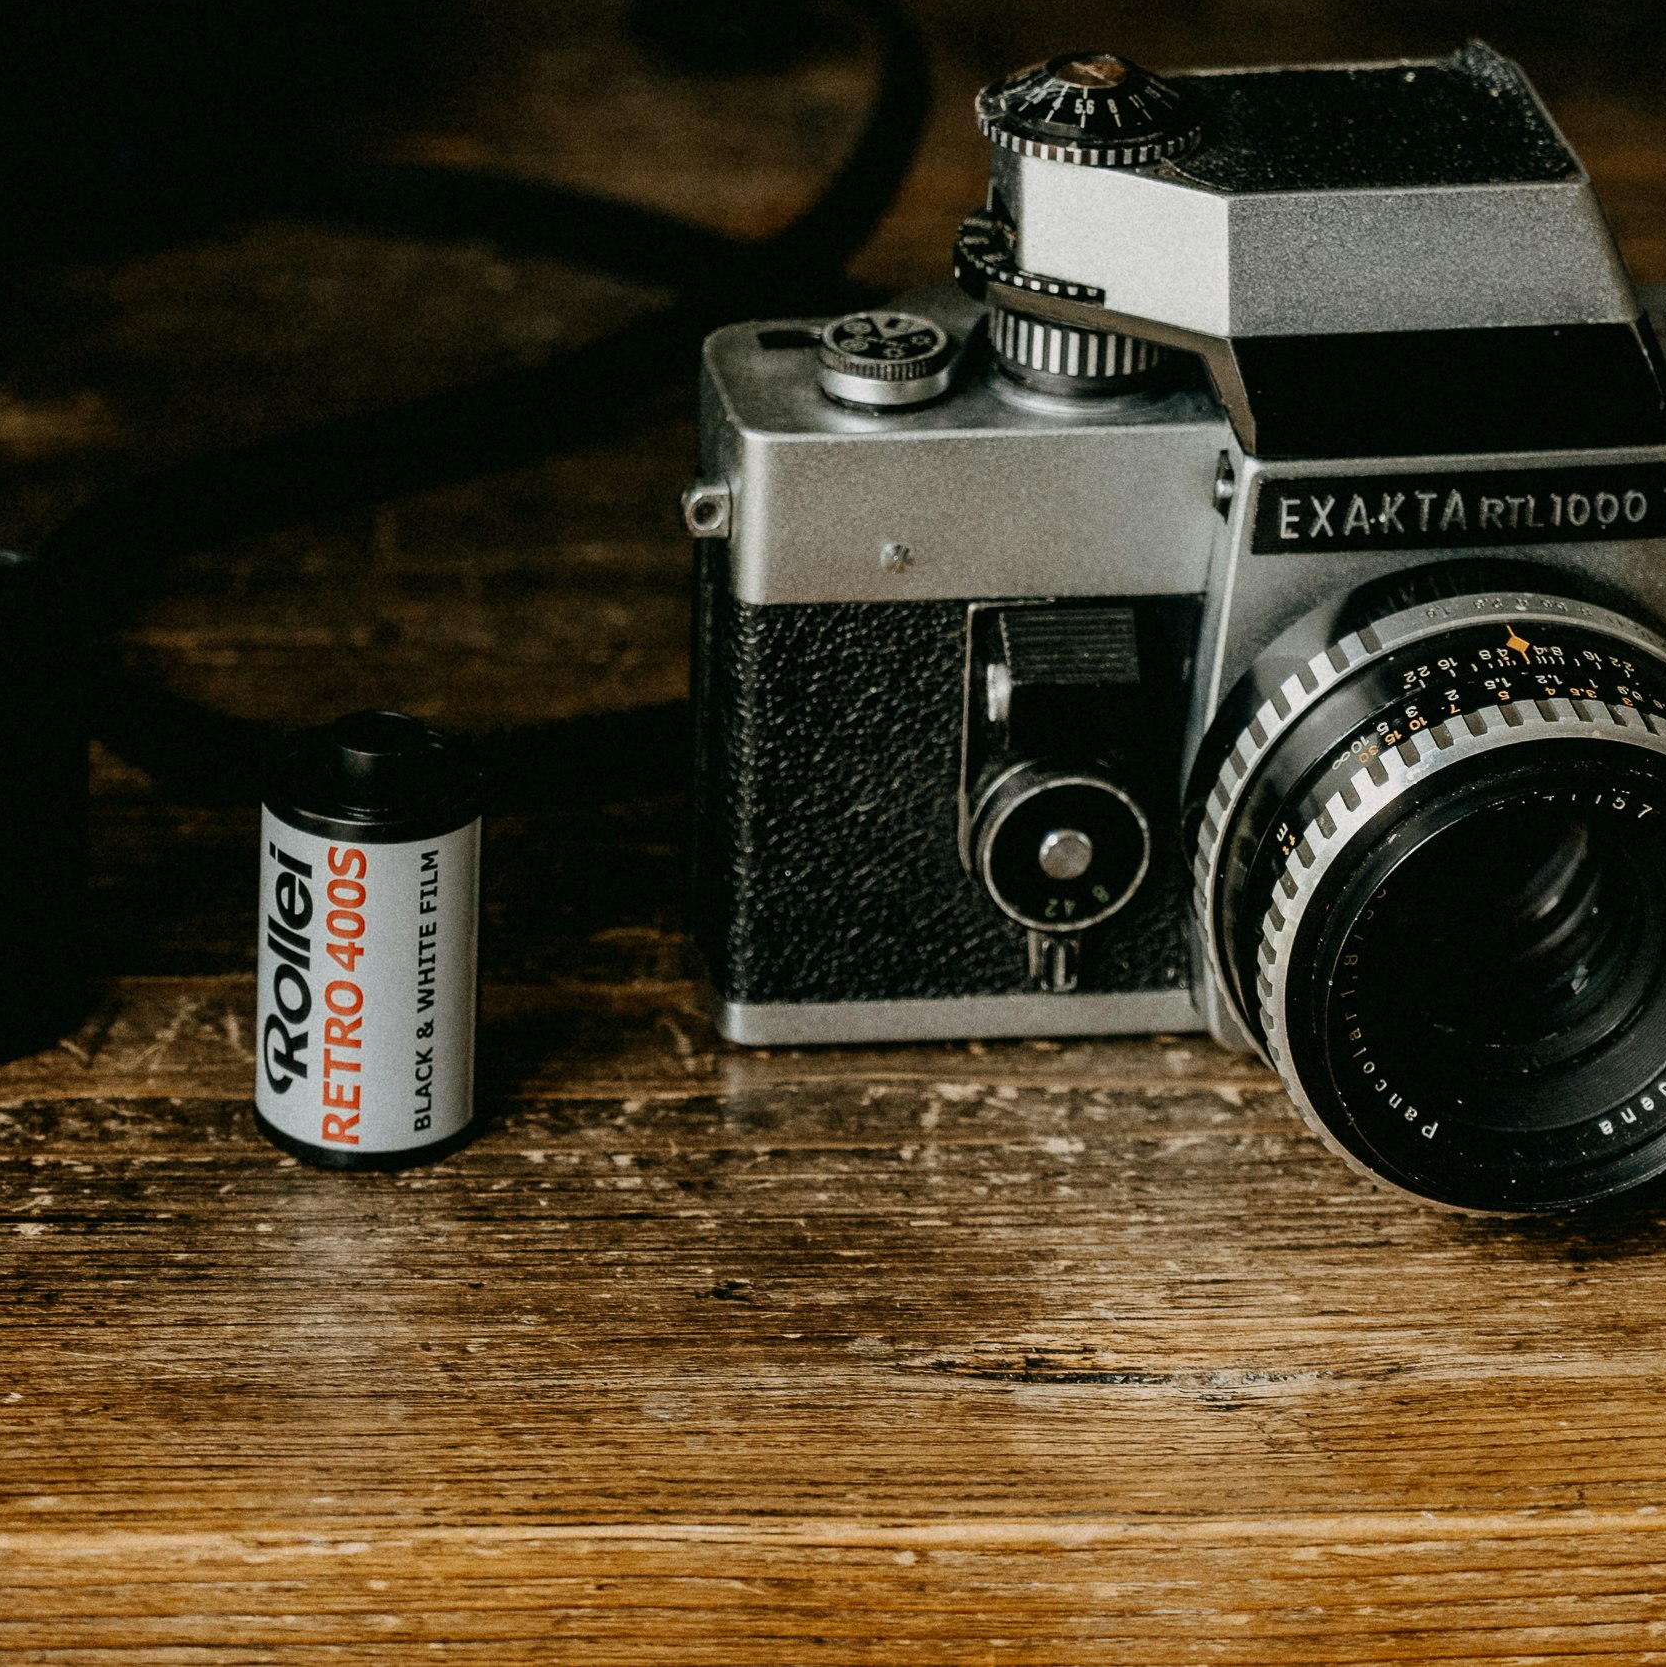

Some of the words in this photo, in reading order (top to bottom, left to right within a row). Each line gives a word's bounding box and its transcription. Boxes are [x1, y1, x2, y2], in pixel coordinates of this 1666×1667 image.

[1107, 98, 1118, 114] 8
[1279, 488, 1469, 540] EXAKTA
[1437, 657, 1459, 671] 16
[1404, 665, 1431, 683] 22
[1535, 674, 1563, 685] 1.2
[1484, 677, 1512, 690] 1.5
[1444, 689, 1460, 701] 2
[1497, 690, 1511, 701] 5
[1405, 705, 1419, 718] 3
[1376, 721, 1390, 736] 5
[1408, 716, 1428, 731] 10
[1350, 735, 1370, 754] 10
[1384, 730, 1403, 746] 15
[419, 849, 439, 915] FILM
[325, 846, 368, 973] 400S
[263, 840, 313, 1095] Rollei
[417, 921, 437, 1013] WHITE
[416, 1018, 435, 1039] &
[321, 980, 364, 1145] RETRO
[414, 1046, 433, 1132] BLACK
